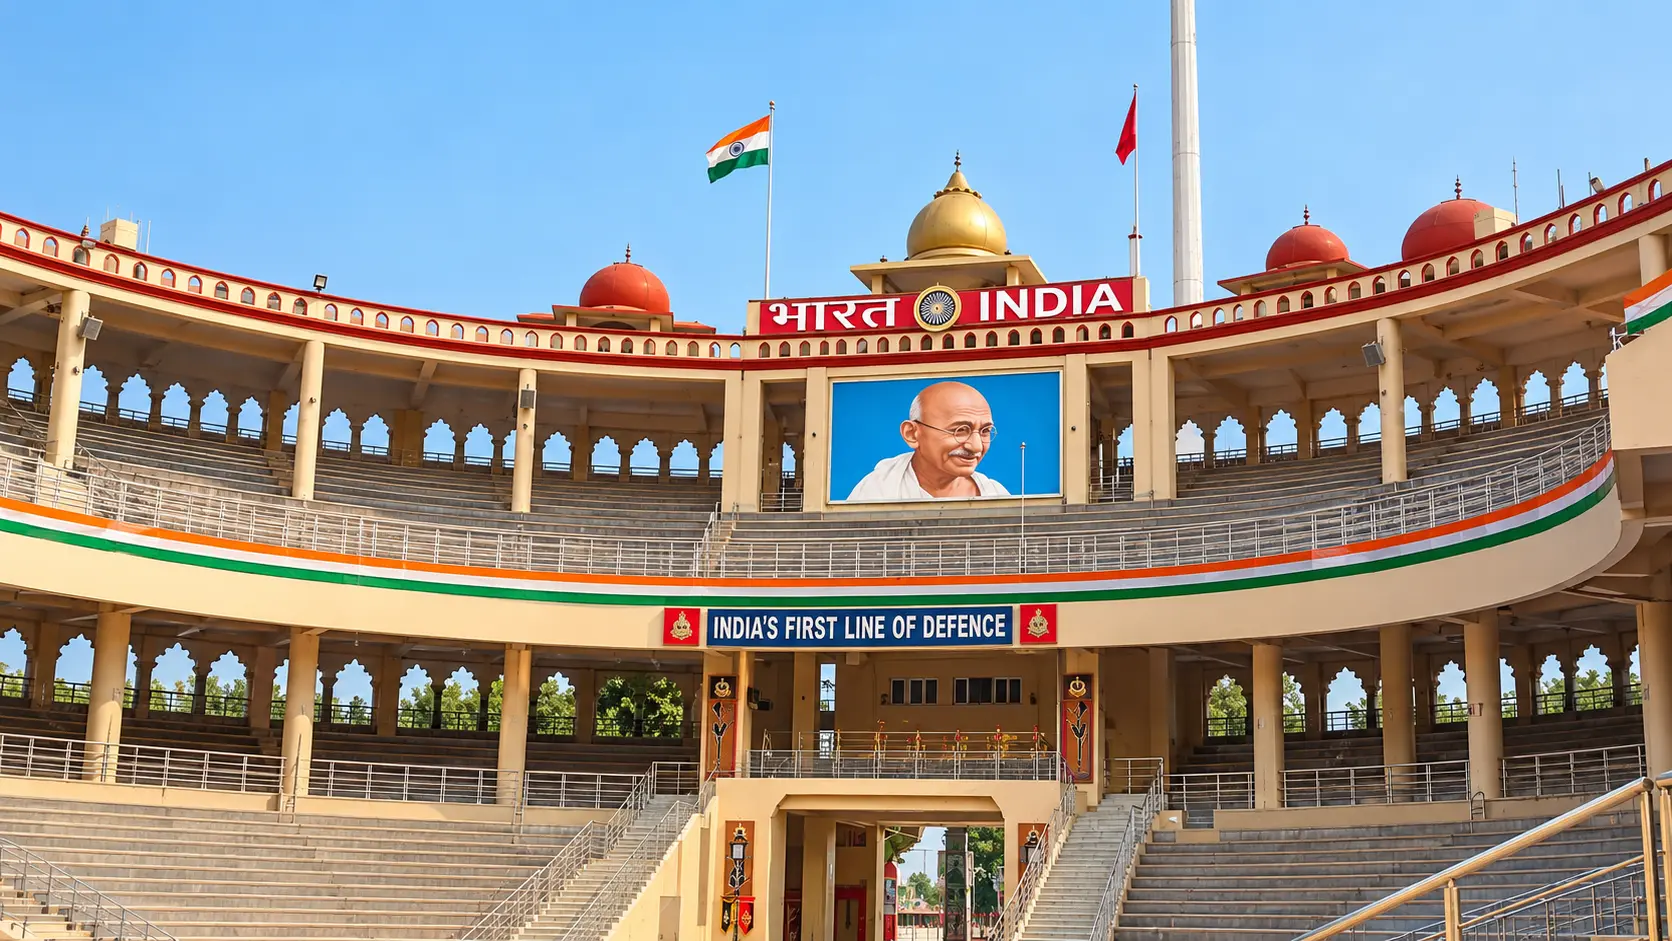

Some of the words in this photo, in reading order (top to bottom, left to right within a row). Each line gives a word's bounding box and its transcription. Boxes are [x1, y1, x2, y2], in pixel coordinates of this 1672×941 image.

[768, 297, 901, 332] भारत
[980, 283, 1124, 322] INDIA
[713, 616, 778, 640] INDIA'S
[785, 616, 838, 639] FIRST
[844, 615, 886, 639] LINE
[892, 615, 917, 639] OF
[923, 614, 1006, 639] DEFENCE
